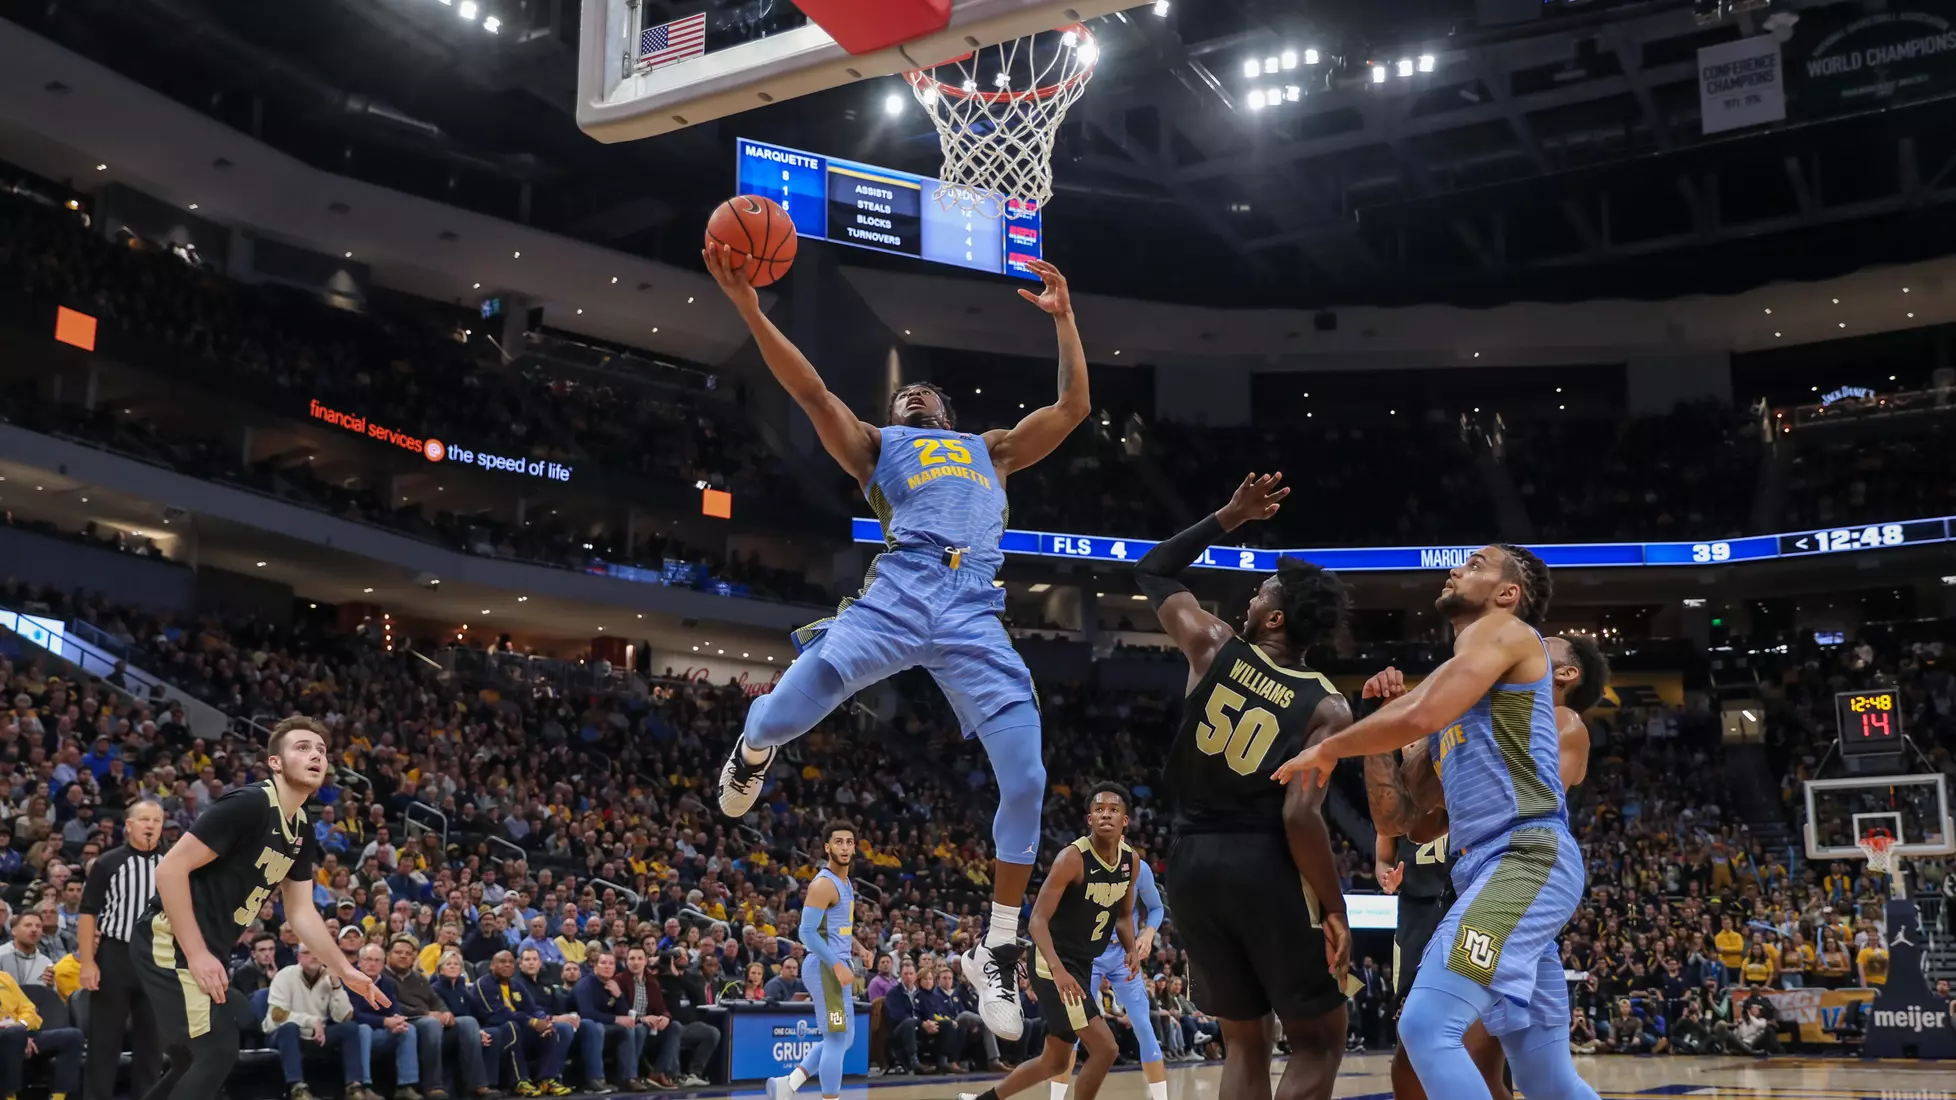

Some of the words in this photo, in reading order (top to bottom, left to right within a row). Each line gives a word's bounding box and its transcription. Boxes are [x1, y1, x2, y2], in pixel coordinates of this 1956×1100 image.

[1806, 51, 1862, 78] WORLD
[1866, 31, 1956, 66] CHAMPIONS
[1703, 53, 1776, 81] CONFERENCE
[1707, 69, 1774, 94] CHAMPIONS
[745, 145, 818, 170] MARQUETTE
[782, 170, 790, 181] 8
[782, 186, 789, 196] 1
[855, 184, 893, 200] ASSISTS
[857, 199, 891, 215] STEALS
[857, 214, 891, 230] BLOCKS
[965, 222, 972, 232] 4
[847, 227, 901, 246] TURNOVERS
[965, 236, 972, 247] 4
[310, 399, 366, 434] financial
[368, 425, 423, 453] services
[447, 444, 474, 463] the
[477, 452, 525, 473] speed
[528, 461, 545, 477] of
[913, 438, 973, 467] 25
[1053, 537, 1091, 555] FLS
[1110, 542, 1127, 559] 4
[1814, 524, 1904, 552] 12:48
[1239, 551, 1255, 569] 2
[1692, 542, 1730, 562] 39
[1229, 658, 1295, 708] WILLIAMS
[1850, 694, 1892, 712] 12:48
[1195, 682, 1280, 776] 50
[1862, 713, 1890, 736] 14
[1091, 910, 1110, 941] 2
[1464, 929, 1496, 968] MU
[1874, 1005, 1946, 1032] meijer
